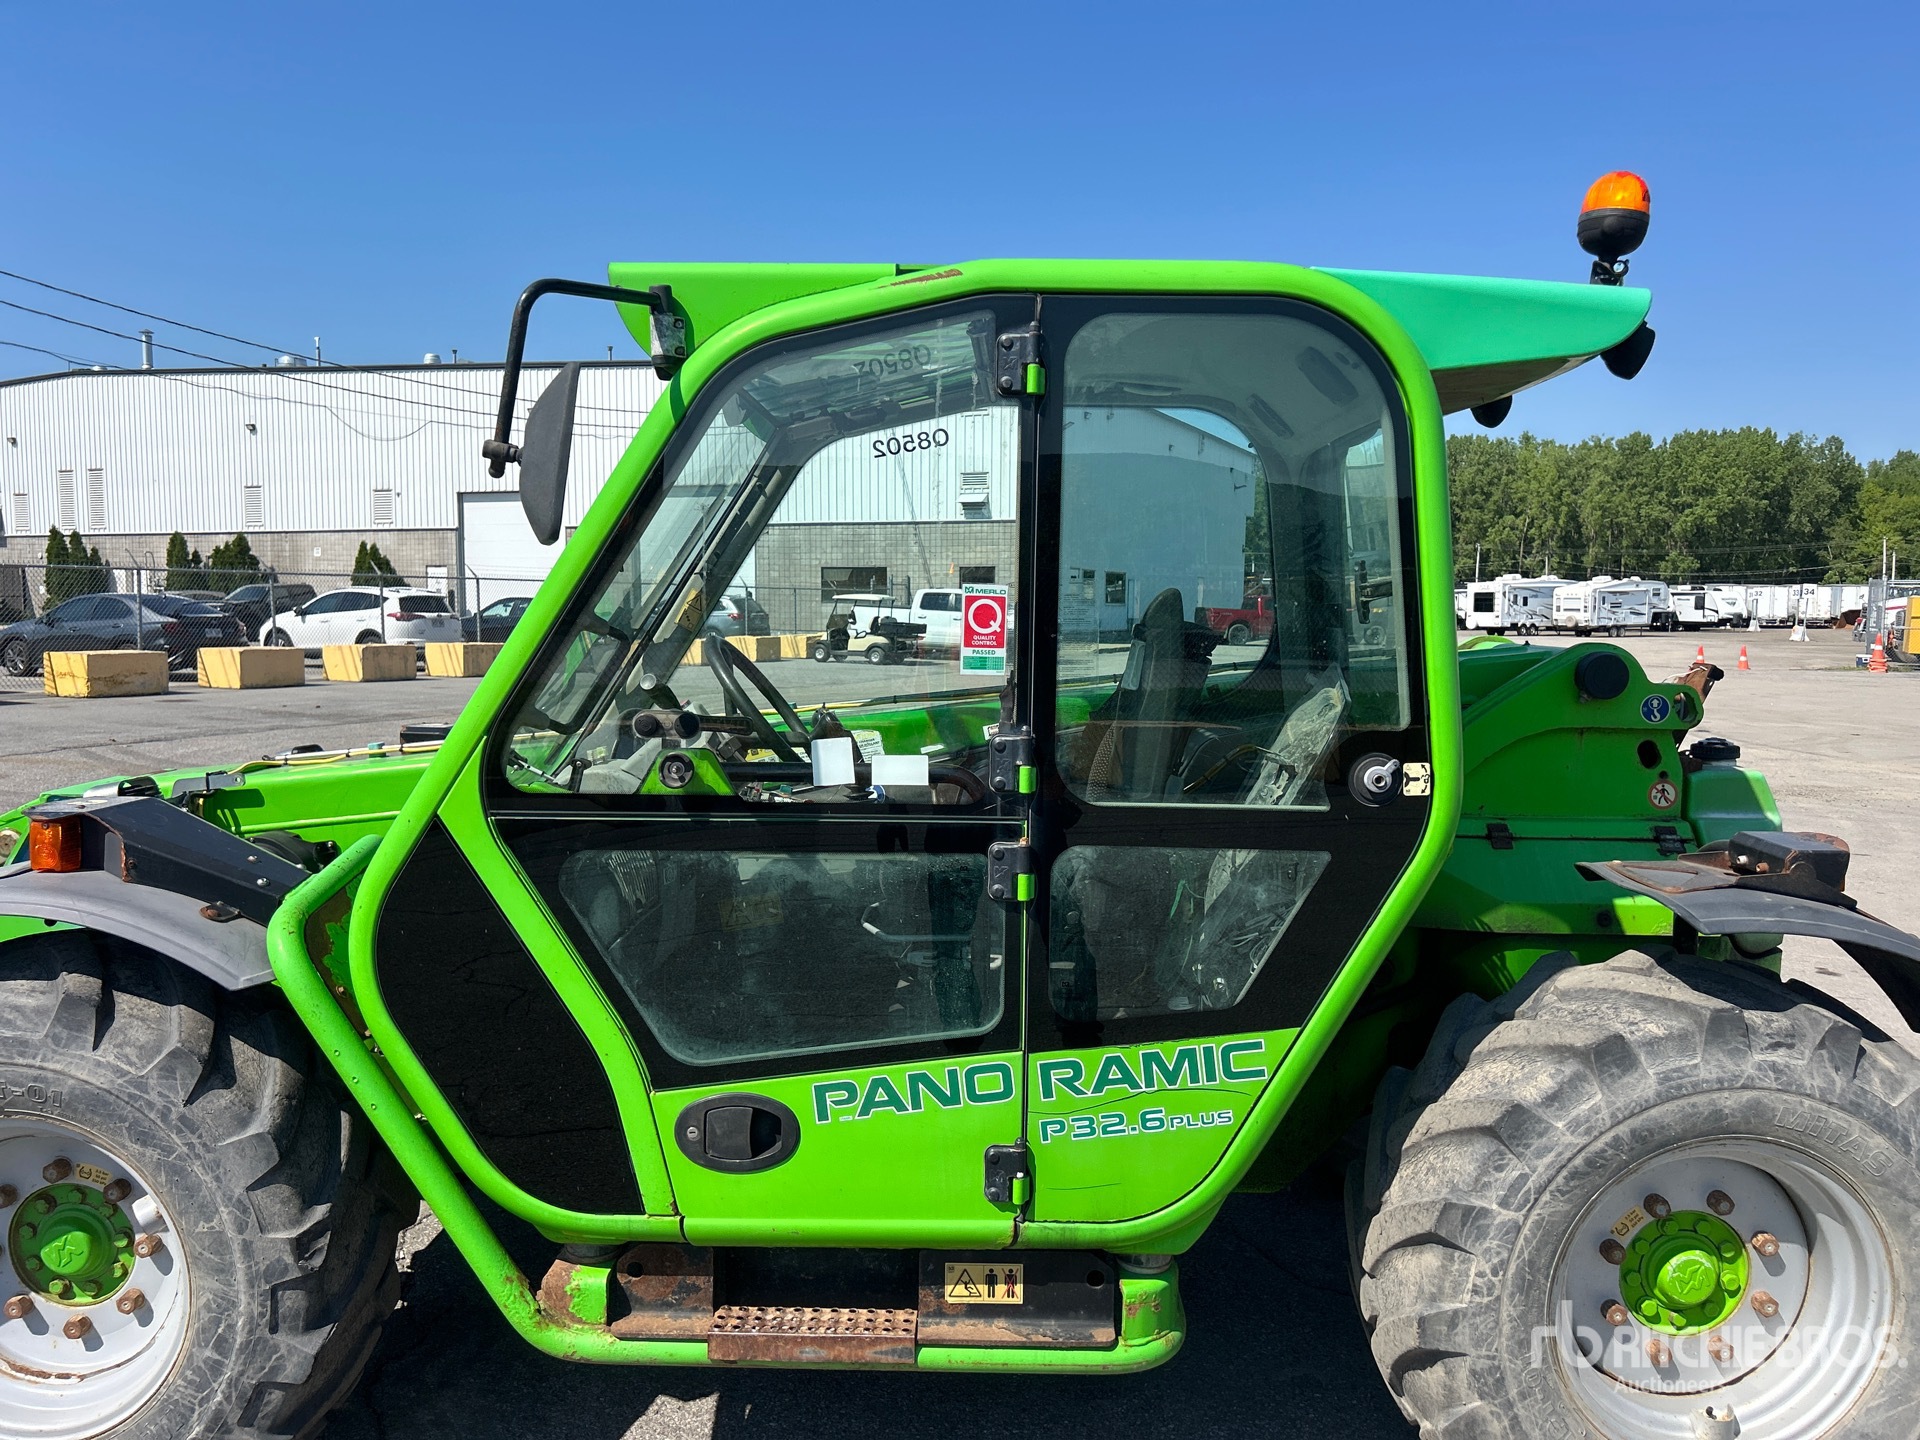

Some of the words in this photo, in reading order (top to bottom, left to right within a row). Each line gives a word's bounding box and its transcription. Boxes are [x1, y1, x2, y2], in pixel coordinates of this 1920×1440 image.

[1803, 588, 1815, 596] 34
[967, 598, 1003, 634] Q
[811, 1061, 1015, 1124] PANO
[1036, 1039, 1267, 1101] RAMIC
[1168, 1110, 1233, 1131] PLUS
[1775, 1106, 1893, 1176] MITAS
